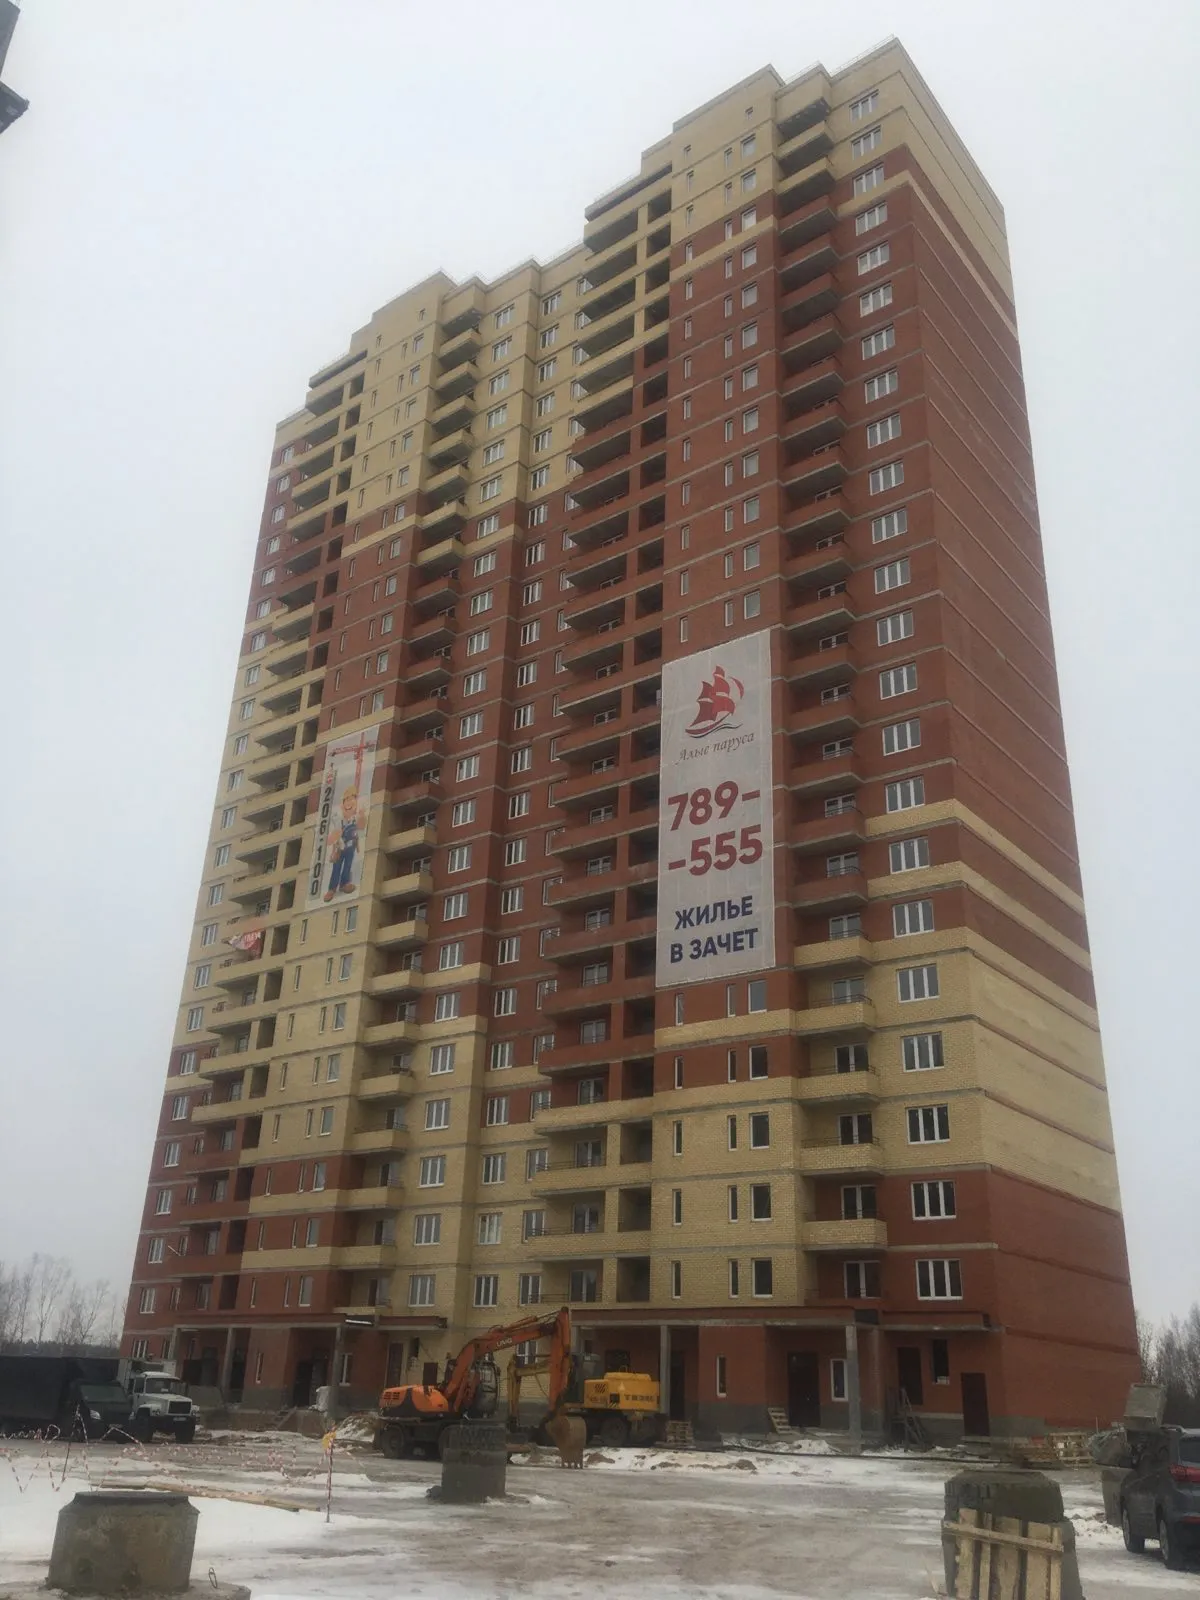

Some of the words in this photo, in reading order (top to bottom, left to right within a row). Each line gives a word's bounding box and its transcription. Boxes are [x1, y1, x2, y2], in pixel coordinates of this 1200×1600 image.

[675, 746, 710, 765] Алые
[713, 733, 754, 752] паруса
[667, 780, 761, 831] 789-
[668, 824, 763, 876] -555
[675, 895, 753, 930] ЖИЛЬЕ
[670, 943, 683, 964] В
[689, 928, 758, 961] ЗАЧЕТ
